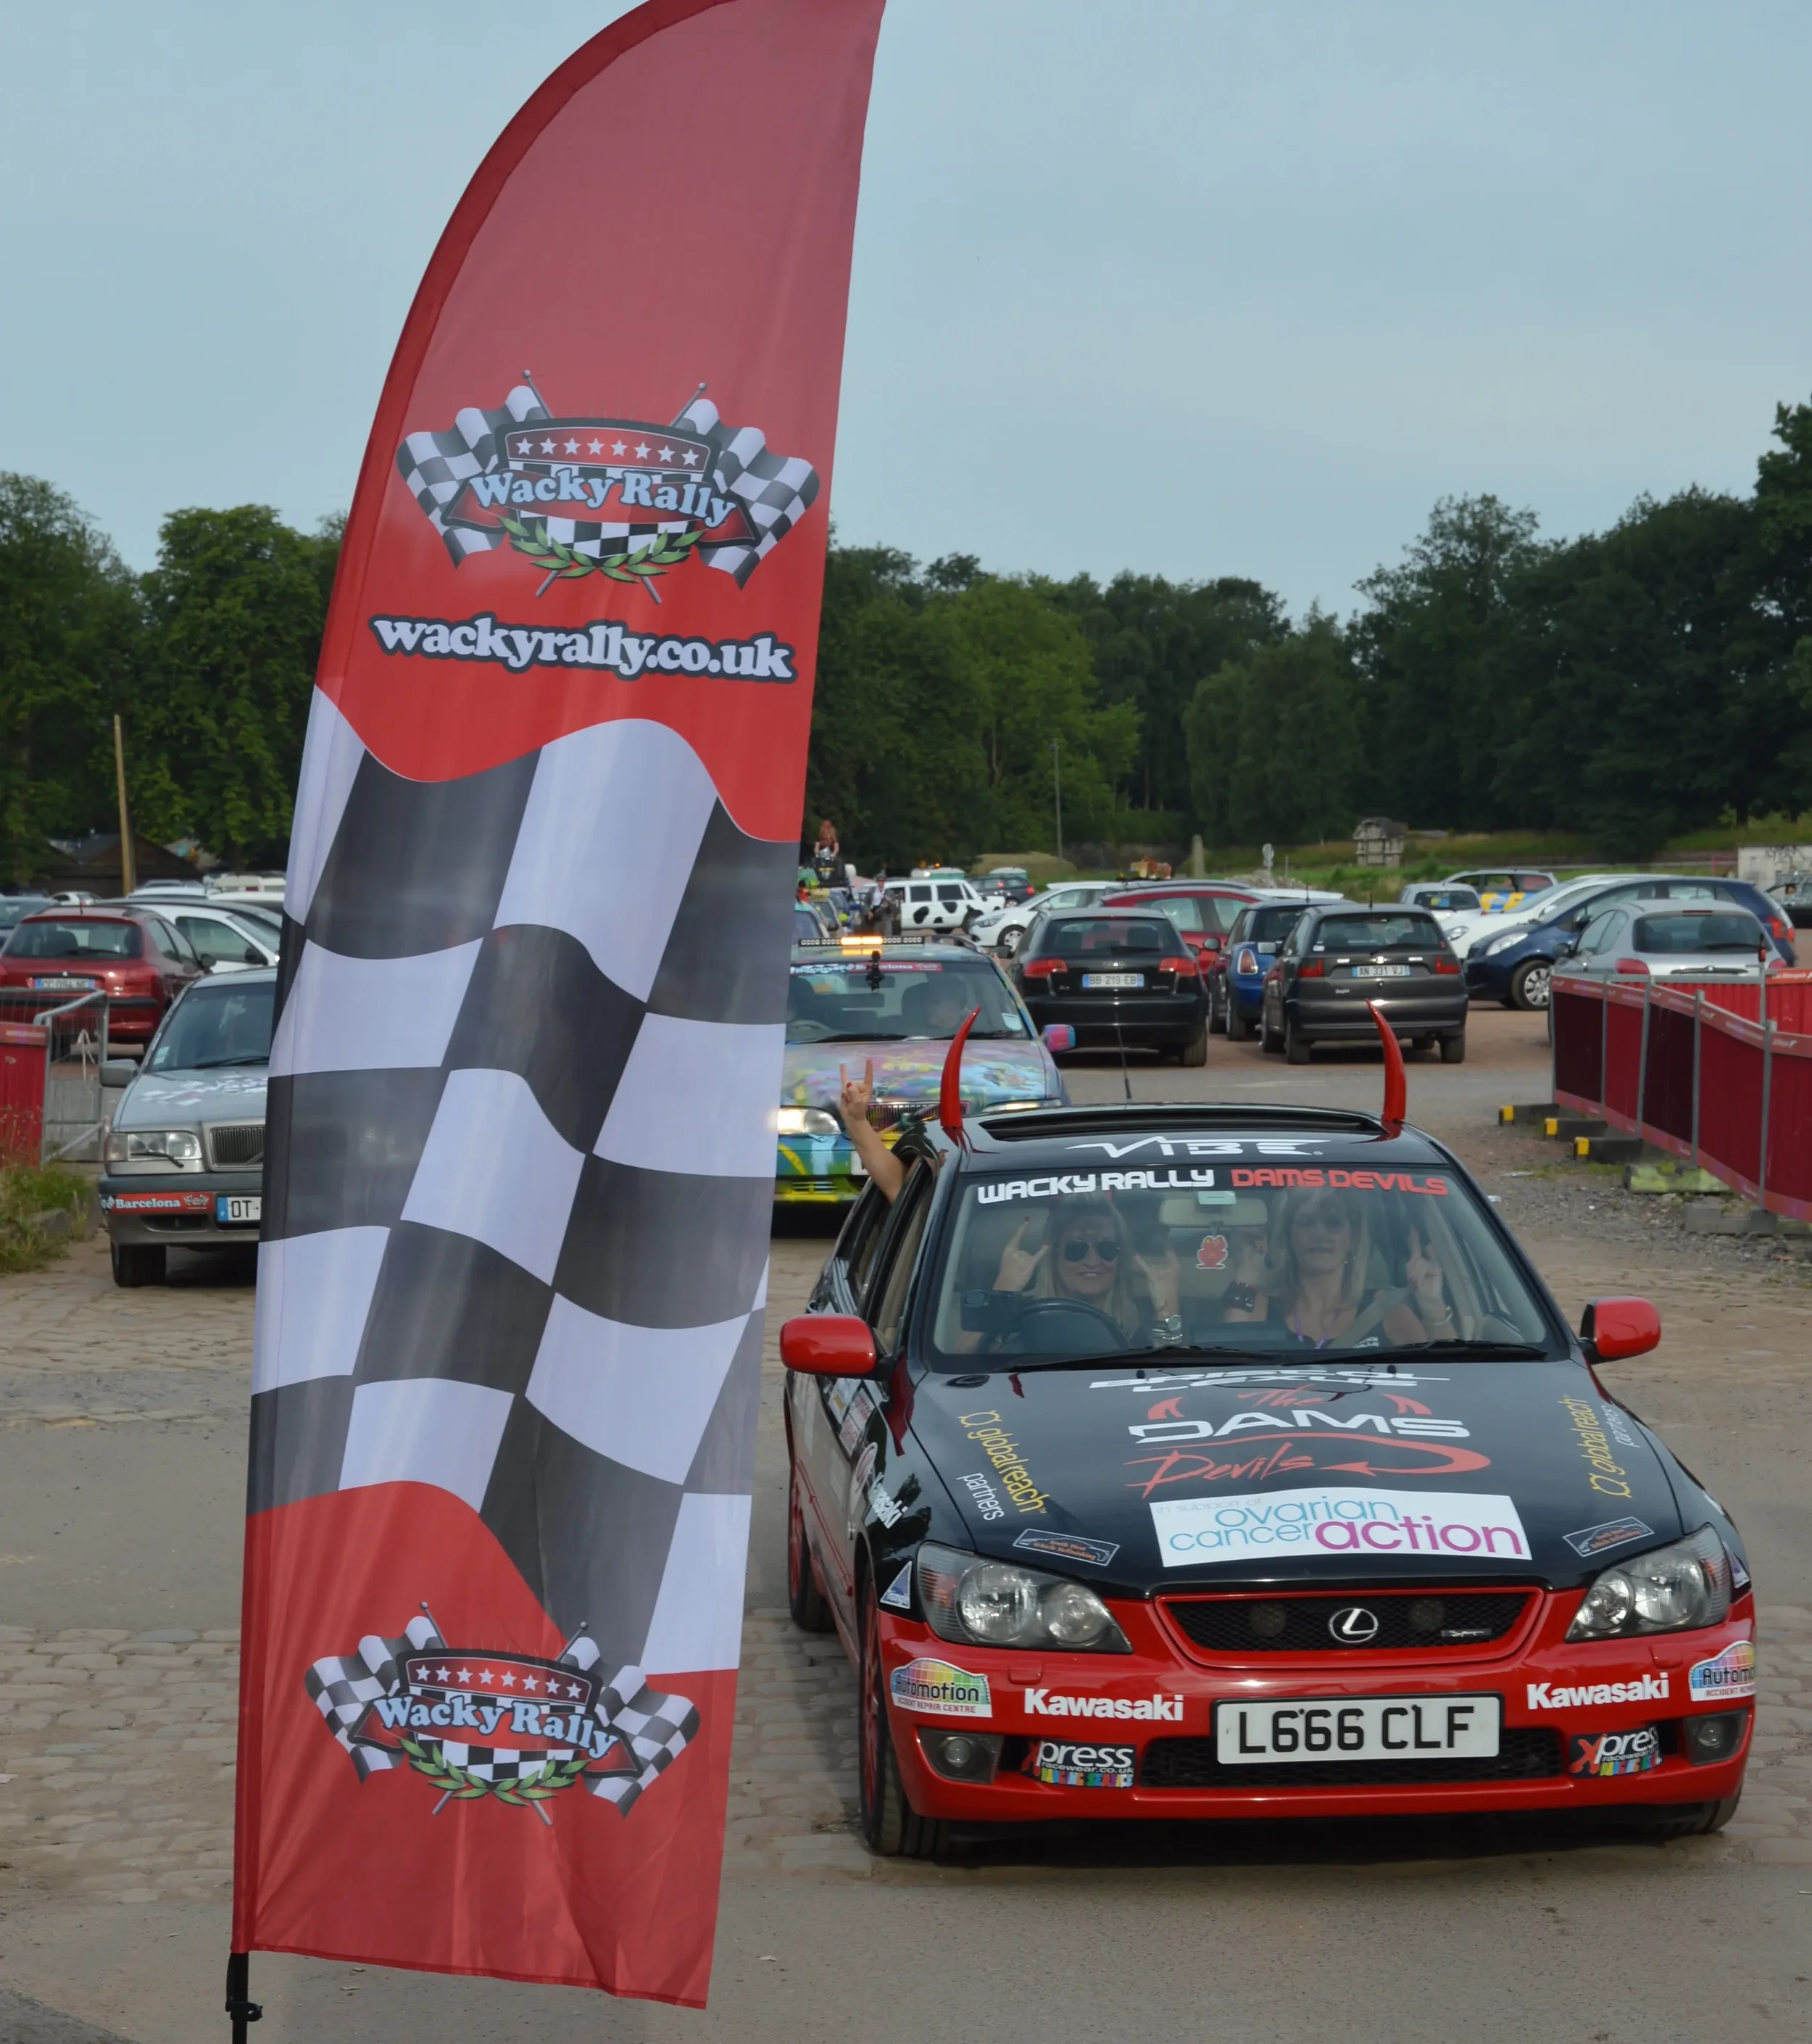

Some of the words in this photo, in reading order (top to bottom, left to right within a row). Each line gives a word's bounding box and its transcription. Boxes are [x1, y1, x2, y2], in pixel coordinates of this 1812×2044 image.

[470, 469, 614, 508] Wacky
[620, 472, 736, 528] Rally
[373, 618, 792, 678] wackyrally.co.uk
[1065, 1135, 1331, 1158] VIBE
[978, 1174, 1096, 1204] WACKY
[1101, 1169, 1215, 1191] RALLY
[1231, 1168, 1326, 1188] DAMS
[1328, 1170, 1448, 1196] DEVILS
[115, 1198, 180, 1209] Barcelona
[1132, 1376, 1418, 1392] LEXUS
[1237, 1384, 1325, 1408] The
[1128, 1410, 1471, 1444] DAMS
[1123, 1442, 1316, 1499] Devils
[956, 1473, 1005, 1521] partners
[1214, 1495, 1399, 1527] ovarian
[1169, 1522, 1314, 1551] cancer
[1315, 1515, 1524, 1555] action
[897, 1674, 979, 1702] Automotion
[1024, 1688, 1184, 1721] Kawasaki
[1526, 1671, 1669, 1710] Kawasaki
[917, 1701, 942, 1711] REPAIR
[943, 1704, 976, 1713] CENTRE
[373, 1696, 505, 1735] Wacky
[510, 1701, 618, 1758] Rally
[1239, 1708, 1364, 1754] L666
[1382, 1705, 1474, 1750] CLF
[1041, 1762, 1134, 1774] racewear.co.uk
